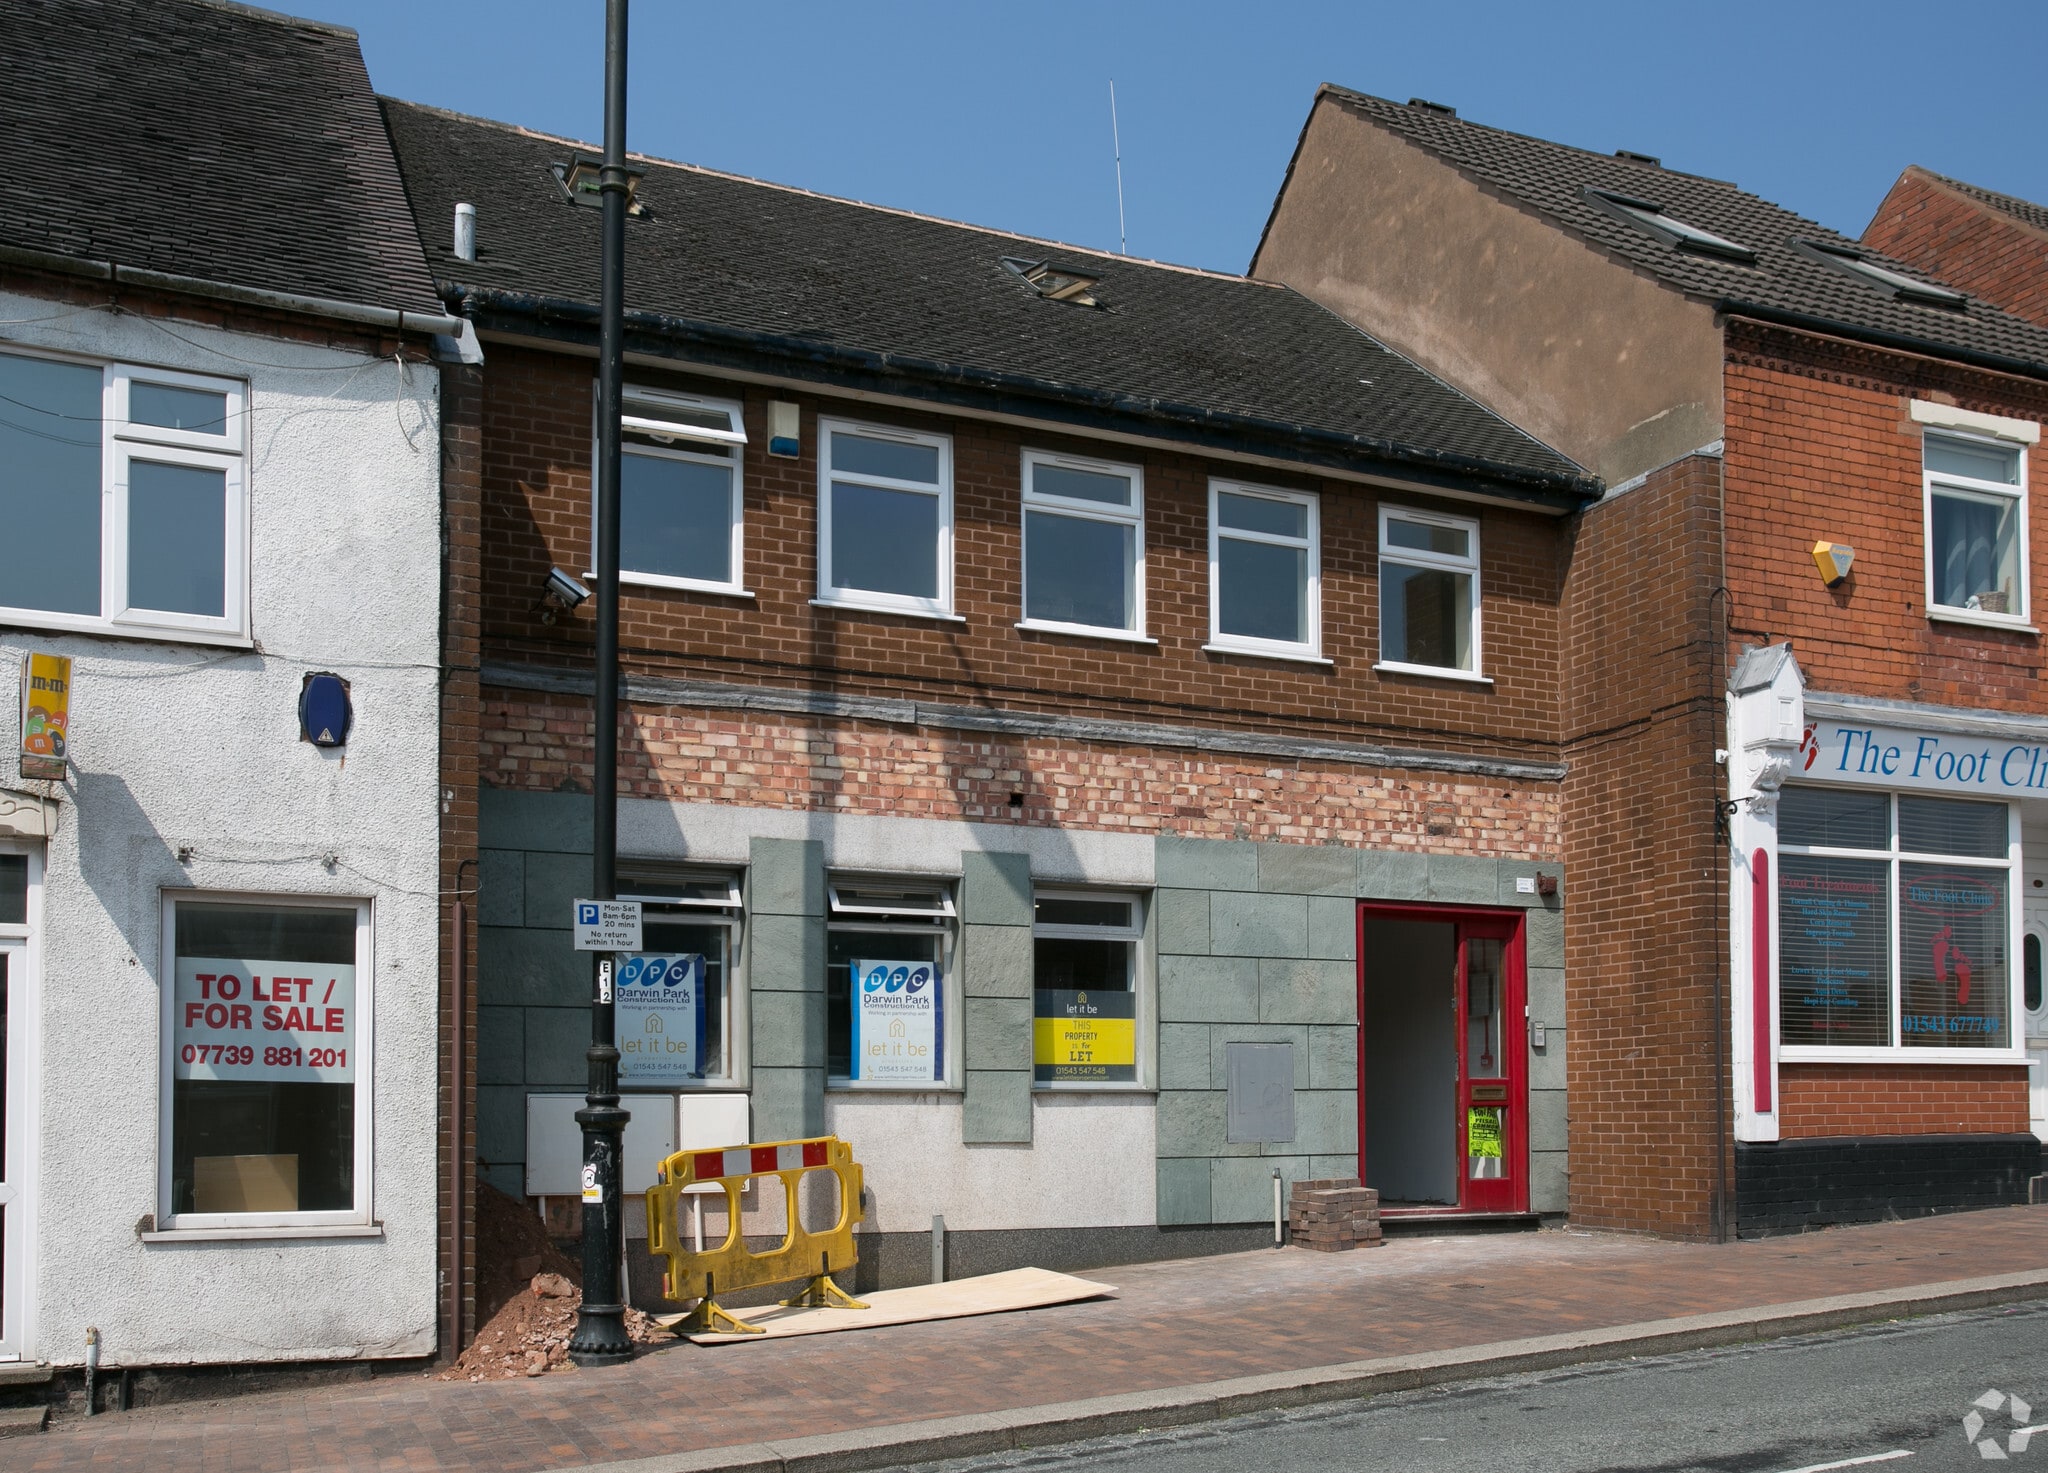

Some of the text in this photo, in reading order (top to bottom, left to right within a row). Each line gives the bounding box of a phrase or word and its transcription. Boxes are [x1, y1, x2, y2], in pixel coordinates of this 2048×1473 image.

[1836, 729, 1900, 776] The
[1909, 737, 1991, 783] Foot
[1909, 886, 1995, 905] The Foot Clinic
[604, 904, 636, 912] Mon-Sat
[583, 907, 595, 922] P
[602, 913, 637, 921] 8am-6pm
[196, 974, 336, 1004] TO LET /
[617, 987, 690, 998] Darwin Park
[863, 994, 929, 1004] Darwin Park
[1066, 1004, 1098, 1013] let it be
[185, 1003, 345, 1032] FOR SALE
[1902, 1014, 1946, 1032] 01543
[1073, 1020, 1091, 1030] THIS
[1064, 1032, 1097, 1040] PROPERTY
[621, 1035, 688, 1053] let it be
[867, 1040, 928, 1057] let it be
[181, 1044, 347, 1068] 07739 881 201
[1069, 1051, 1093, 1062] LET
[633, 1063, 656, 1071] 01543
[1056, 1067, 1106, 1075] 01543 547 548
